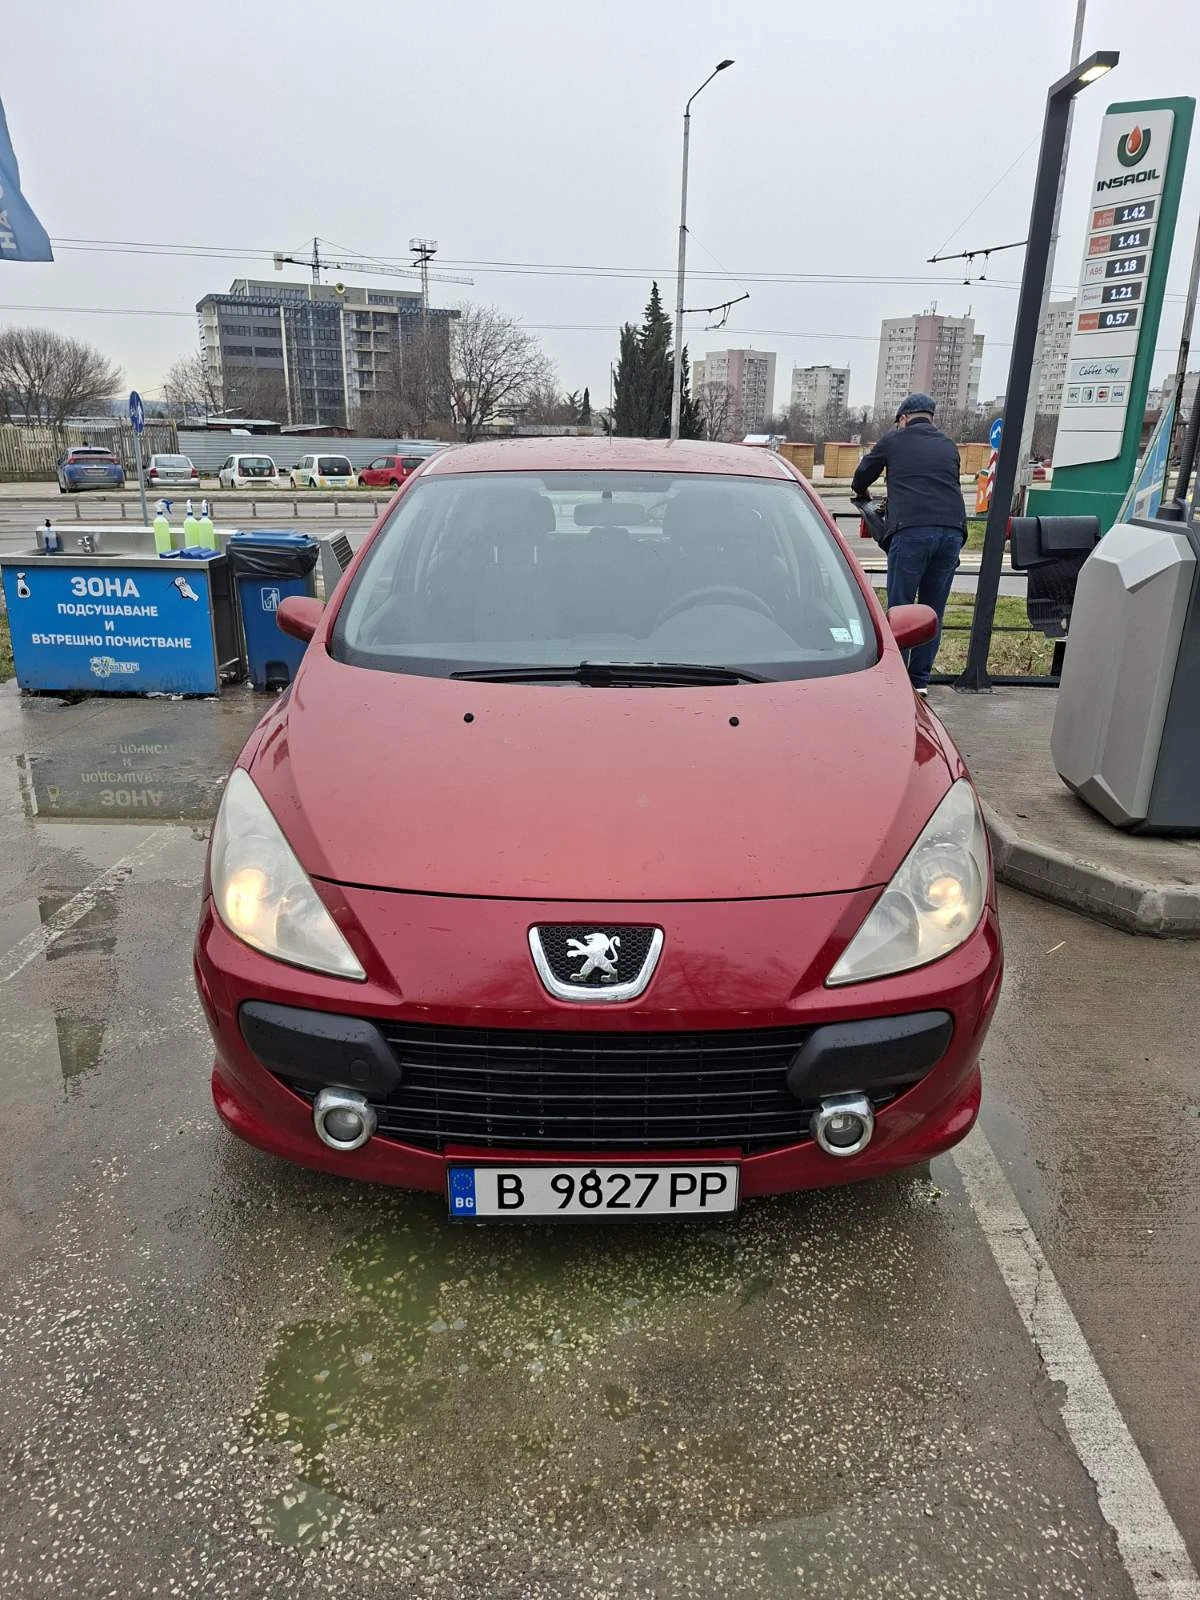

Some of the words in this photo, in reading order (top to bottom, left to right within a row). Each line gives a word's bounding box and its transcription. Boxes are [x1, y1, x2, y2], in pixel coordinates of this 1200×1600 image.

[1096, 168, 1160, 192] INSAOIL
[1121, 205, 1146, 221] 1.42
[1117, 232, 1141, 248] 1.41
[1088, 266, 1104, 276] A95
[1113, 259, 1137, 274] 1.18
[1110, 286, 1133, 300] 1.21
[1106, 312, 1130, 326] 0.57
[70, 576, 140, 598] ЗОНА
[57, 603, 159, 618] ПОДСУШАВАНЕ
[105, 620, 114, 631] И
[31, 633, 104, 647] ВЪТРЕШНО
[105, 635, 192, 649] ПОЧИСТВАНЕ
[496, 1173, 525, 1210] B
[550, 1171, 660, 1210] 9827
[669, 1172, 728, 1208] PP
[455, 1196, 474, 1208] BG
